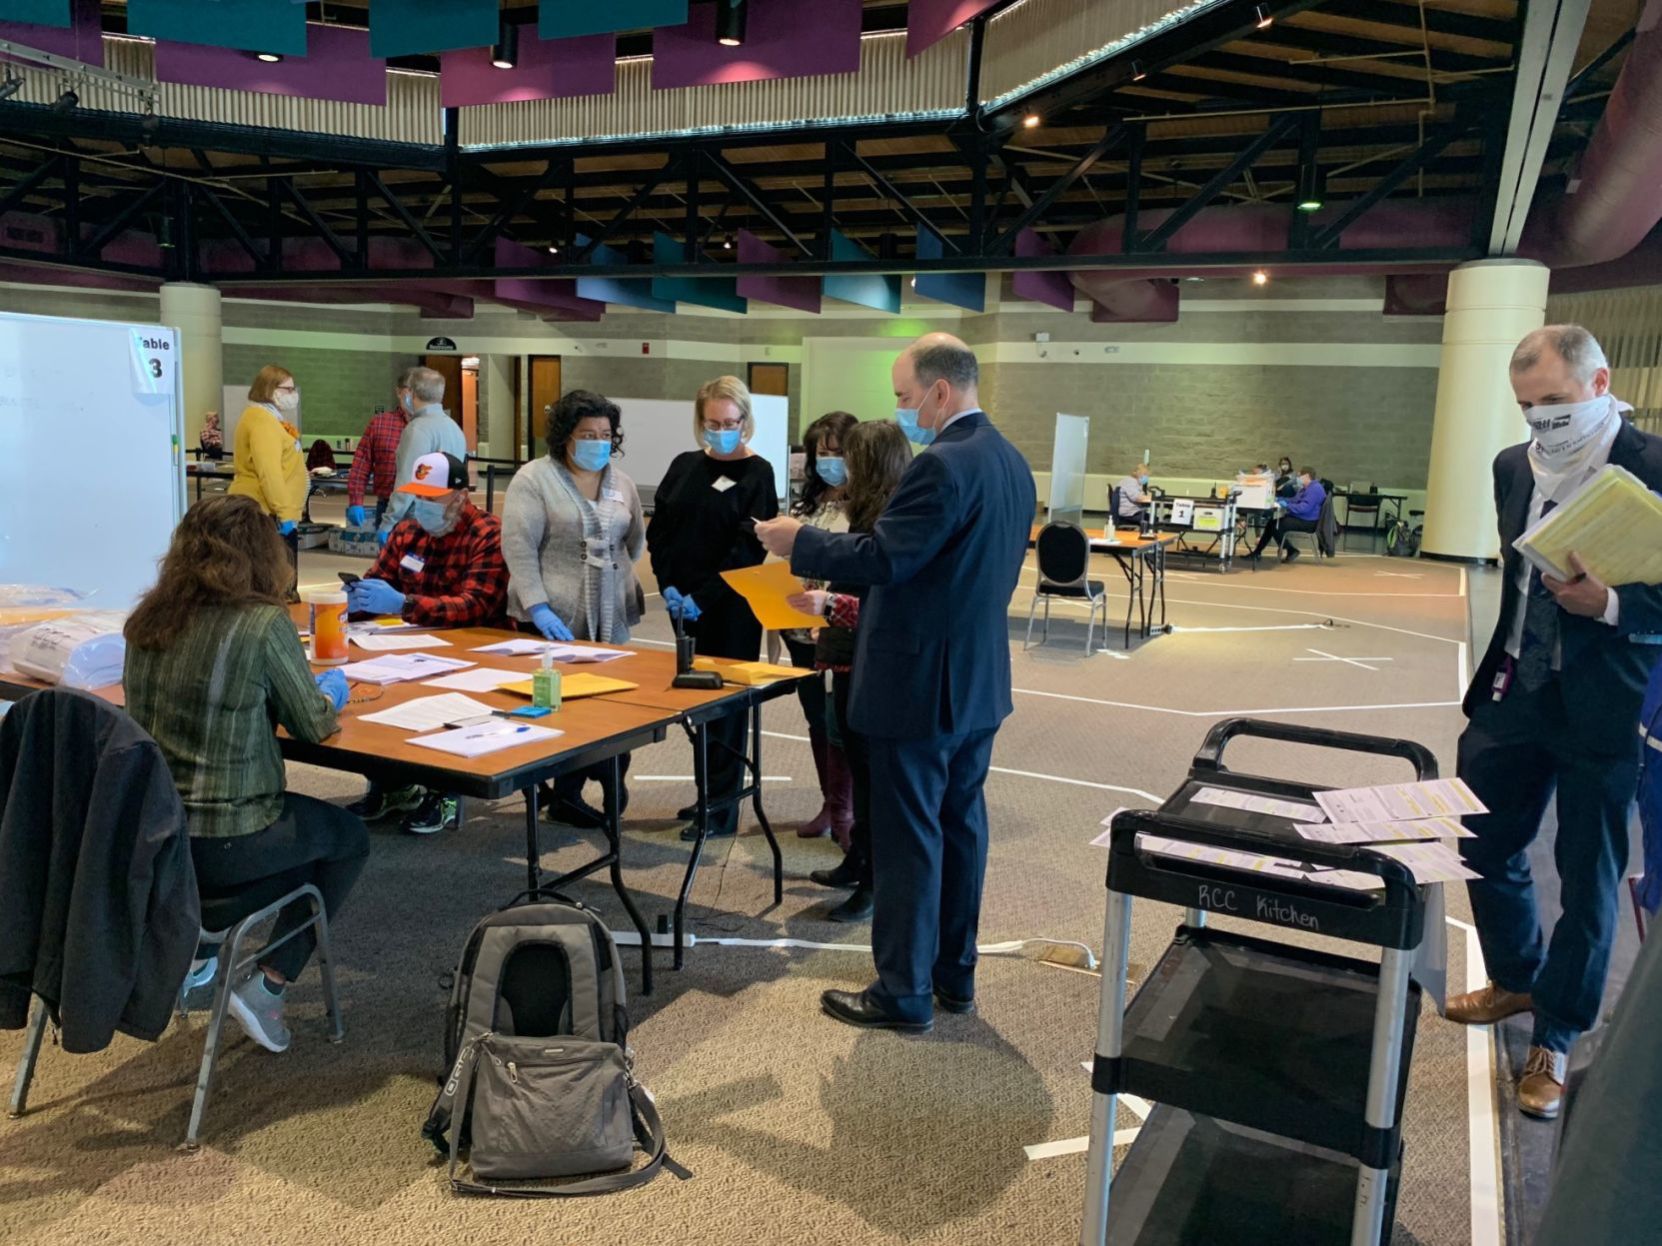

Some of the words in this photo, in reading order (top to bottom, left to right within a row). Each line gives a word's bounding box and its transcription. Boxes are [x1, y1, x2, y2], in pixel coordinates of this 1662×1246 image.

[139, 337, 170, 350] able
[149, 358, 163, 378] 3
[1178, 510, 1185, 518] 1
[1199, 885, 1238, 911] RCC
[1256, 895, 1319, 930] Kitchen
